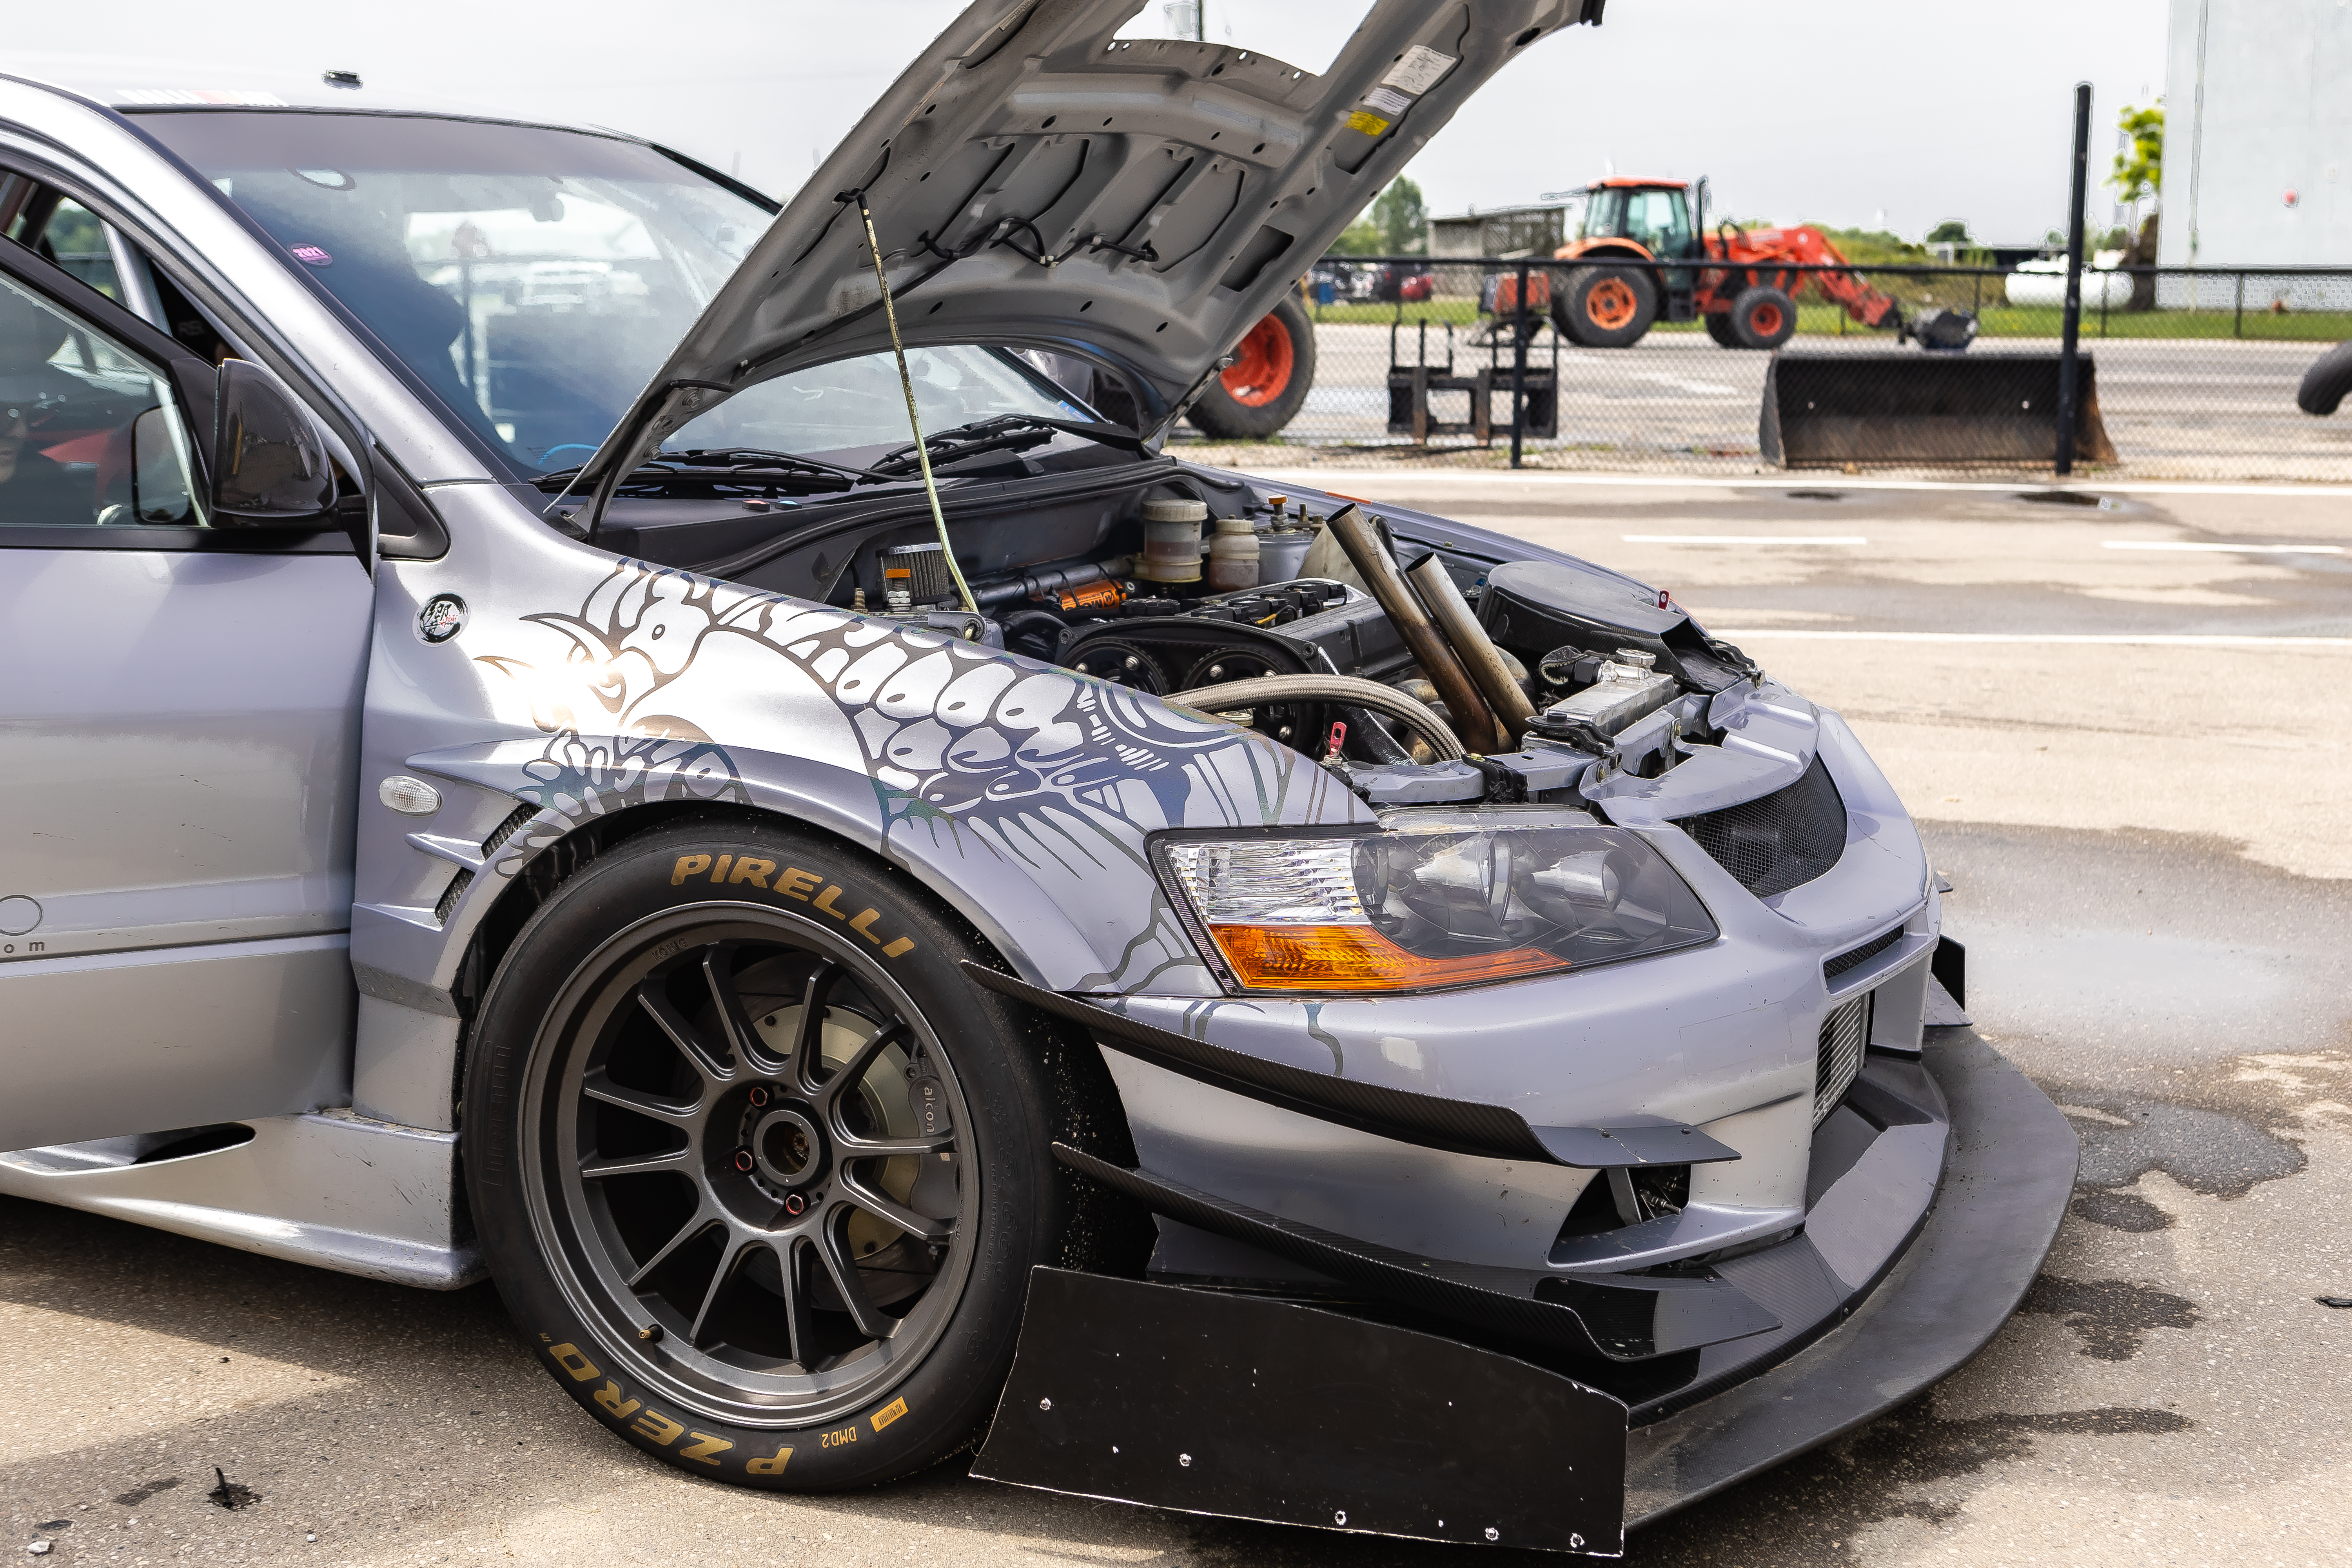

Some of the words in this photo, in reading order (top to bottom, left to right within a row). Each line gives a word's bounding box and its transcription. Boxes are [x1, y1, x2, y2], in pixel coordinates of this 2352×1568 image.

[671, 854, 915, 958] PIRELLI
[539, 949, 573, 990] TUBELESS
[573, 924, 603, 949] RADIAL
[651, 938, 688, 962] KÖNIG
[477, 1044, 512, 1187] PIRELLI
[924, 1087, 936, 1133] alcon
[981, 1261, 990, 1282] ONLY
[539, 1333, 552, 1343] TM
[549, 1343, 733, 1465] ZERO
[822, 1426, 857, 1448] DMD2
[746, 1448, 793, 1474] P
